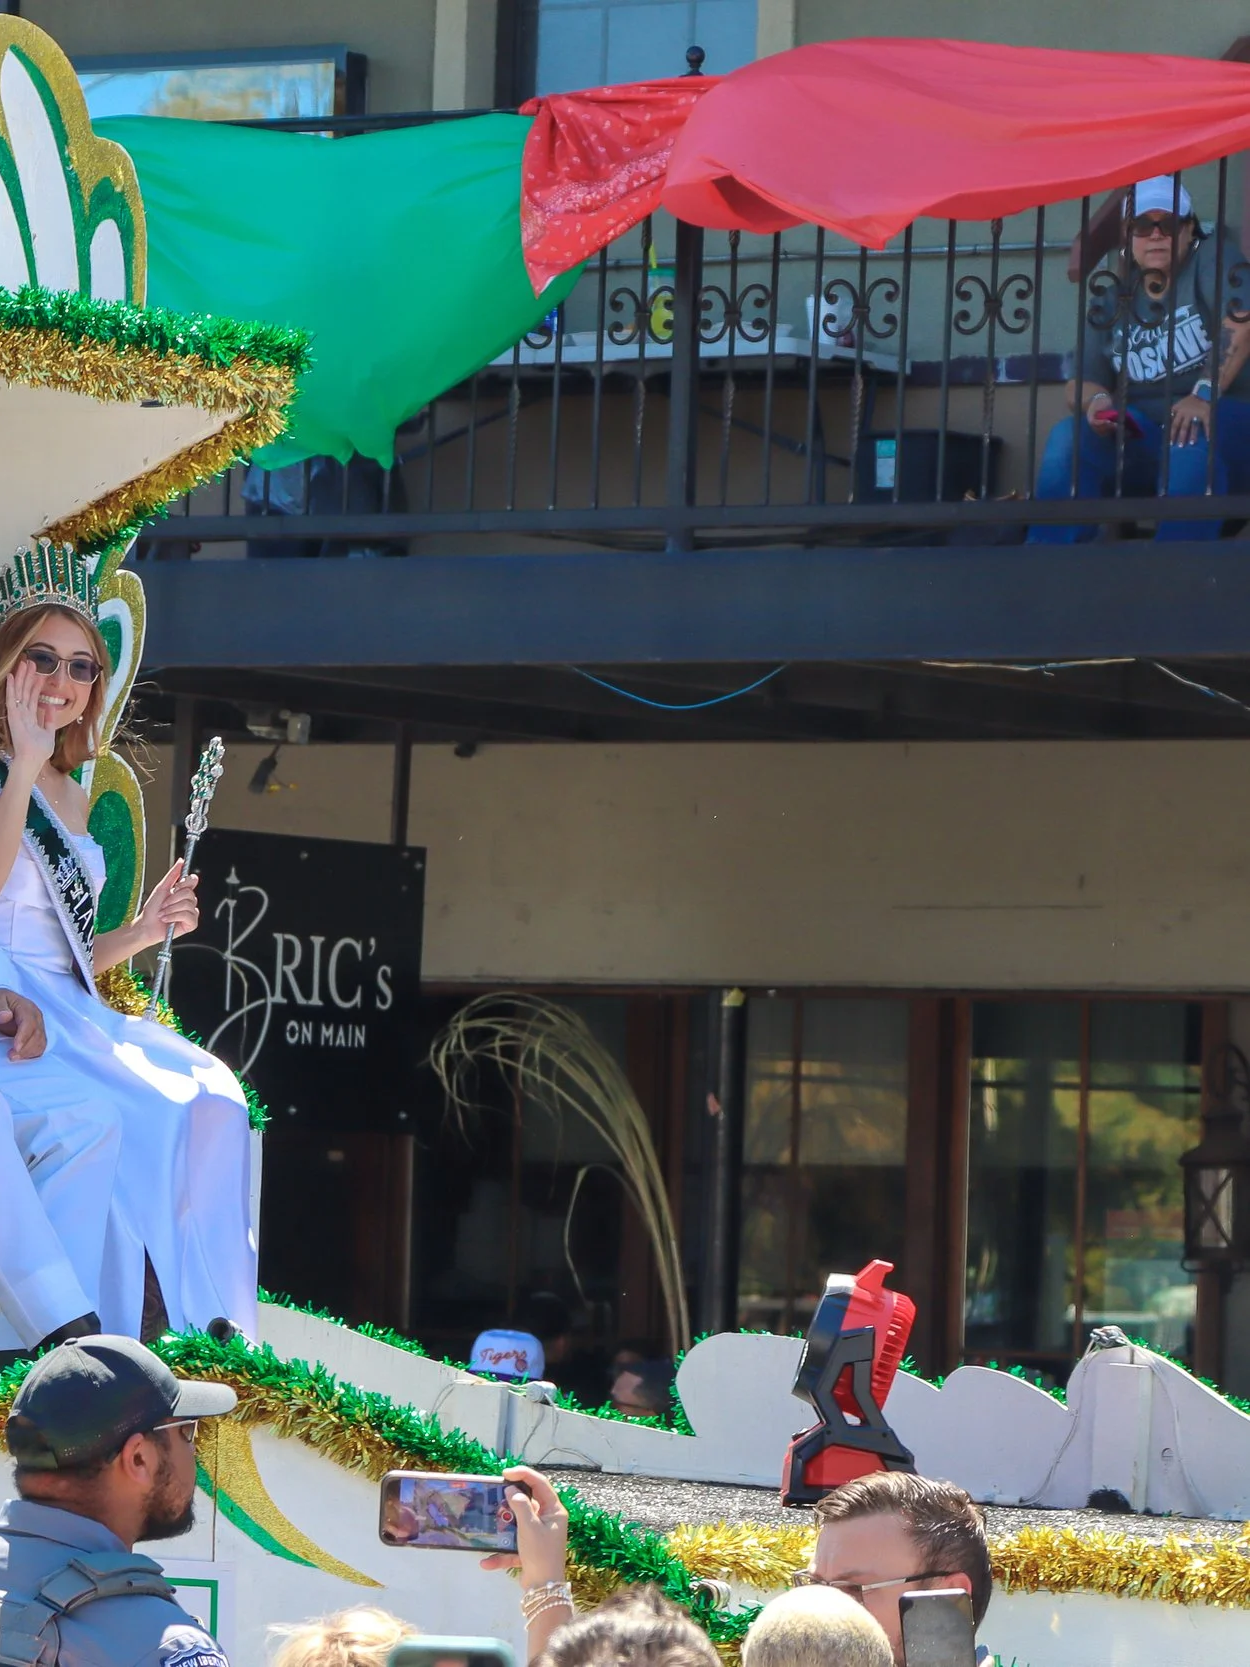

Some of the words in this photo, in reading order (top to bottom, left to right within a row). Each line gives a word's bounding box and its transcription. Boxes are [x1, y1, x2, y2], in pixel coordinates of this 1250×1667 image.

[206, 878, 393, 1076] BRIC's
[286, 1020, 313, 1045] ON
[321, 1023, 366, 1047] MAIN
[479, 1348, 527, 1365] Tigers
